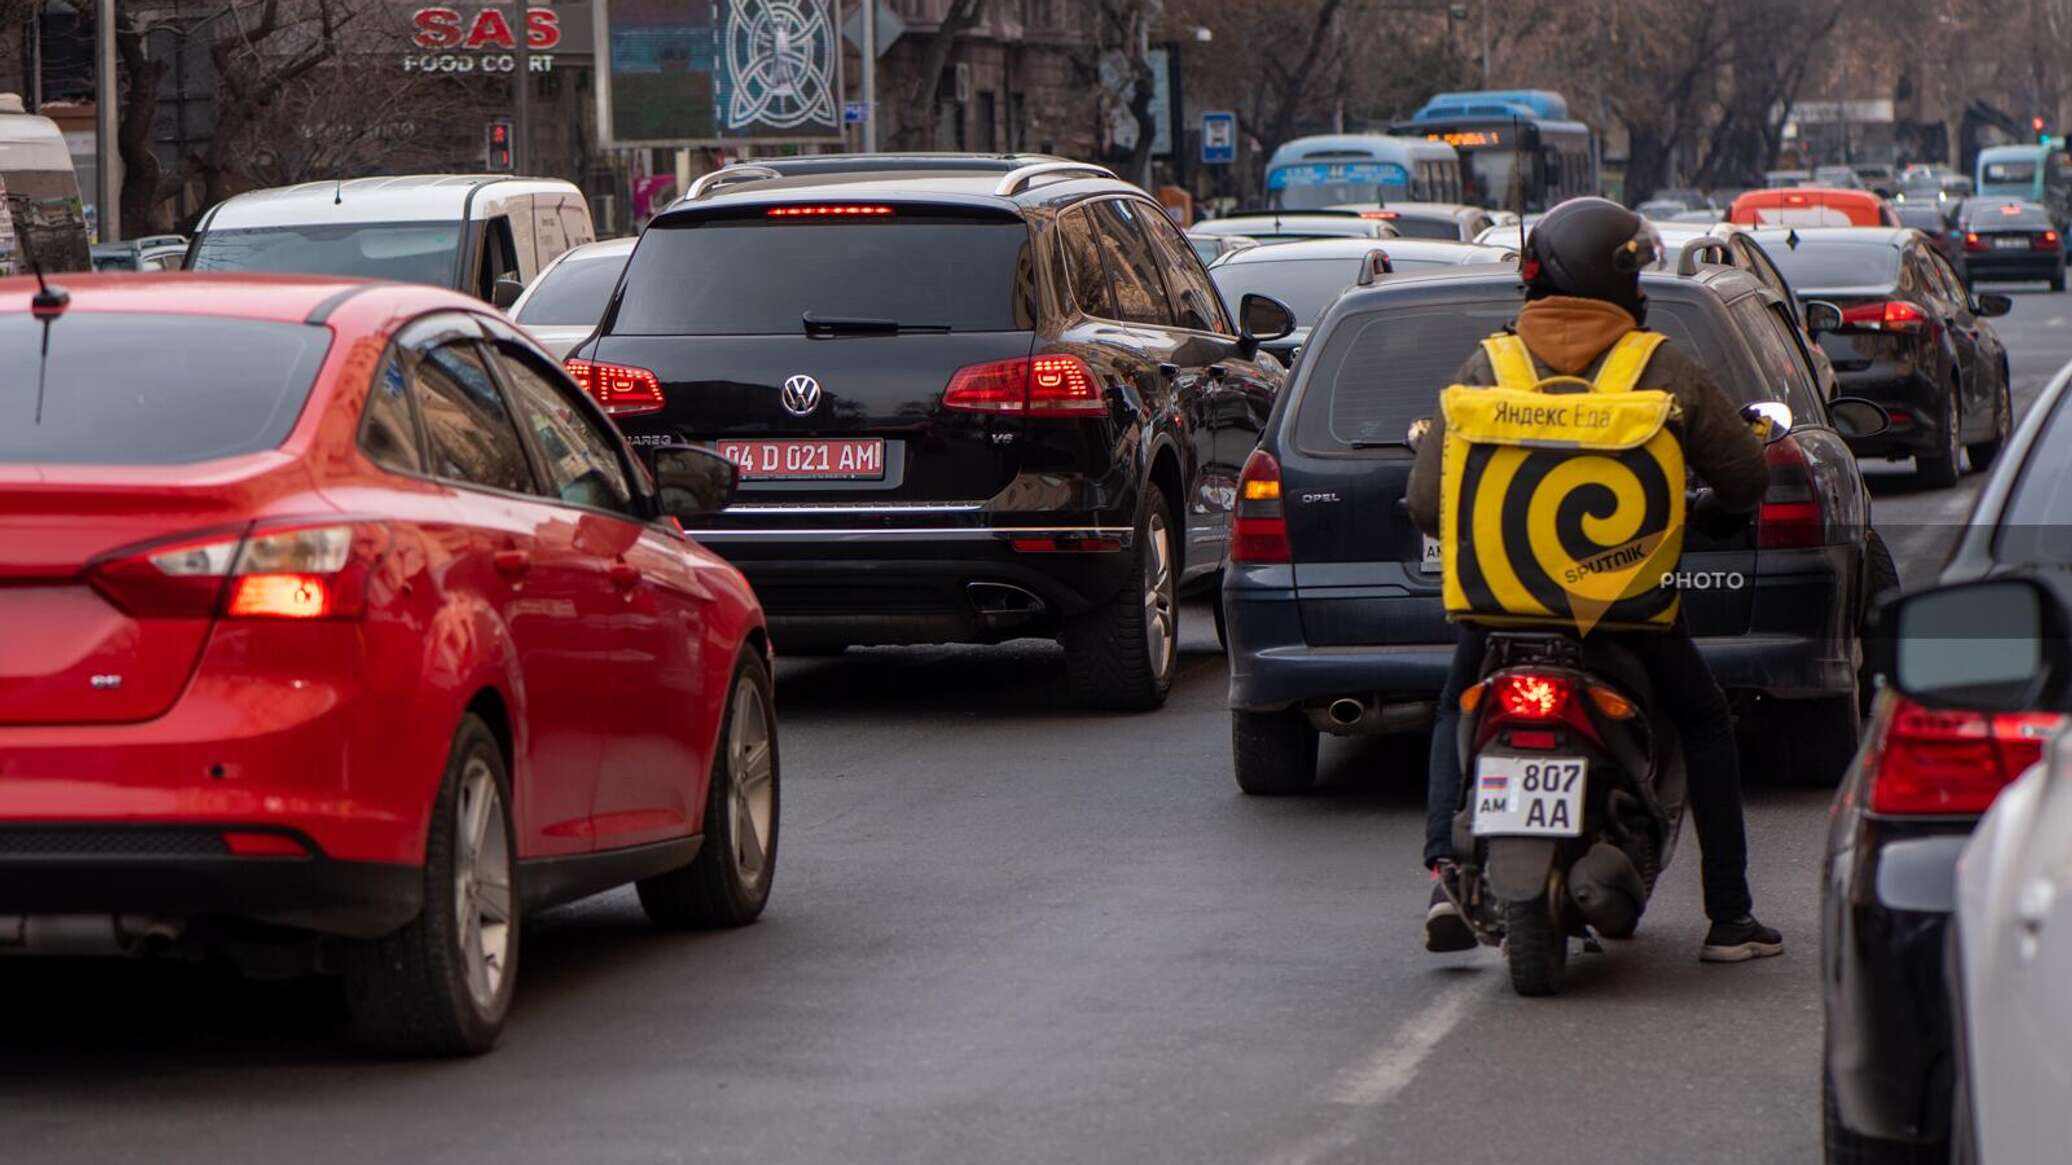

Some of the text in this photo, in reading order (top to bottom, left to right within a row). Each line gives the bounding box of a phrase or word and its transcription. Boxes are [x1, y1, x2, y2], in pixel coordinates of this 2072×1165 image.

[412, 7, 561, 49] SAS
[403, 54, 554, 72] FOOD CORT
[1494, 400, 1611, 429] Яндекс Еда
[627, 434, 672, 446] AREG
[762, 445, 779, 471] D
[786, 445, 830, 471] 021
[838, 444, 874, 471] AM
[1302, 493, 1341, 504] OPEL
[1523, 764, 1580, 793] 807
[1480, 798, 1507, 813] AM
[1525, 797, 1570, 829] AA
